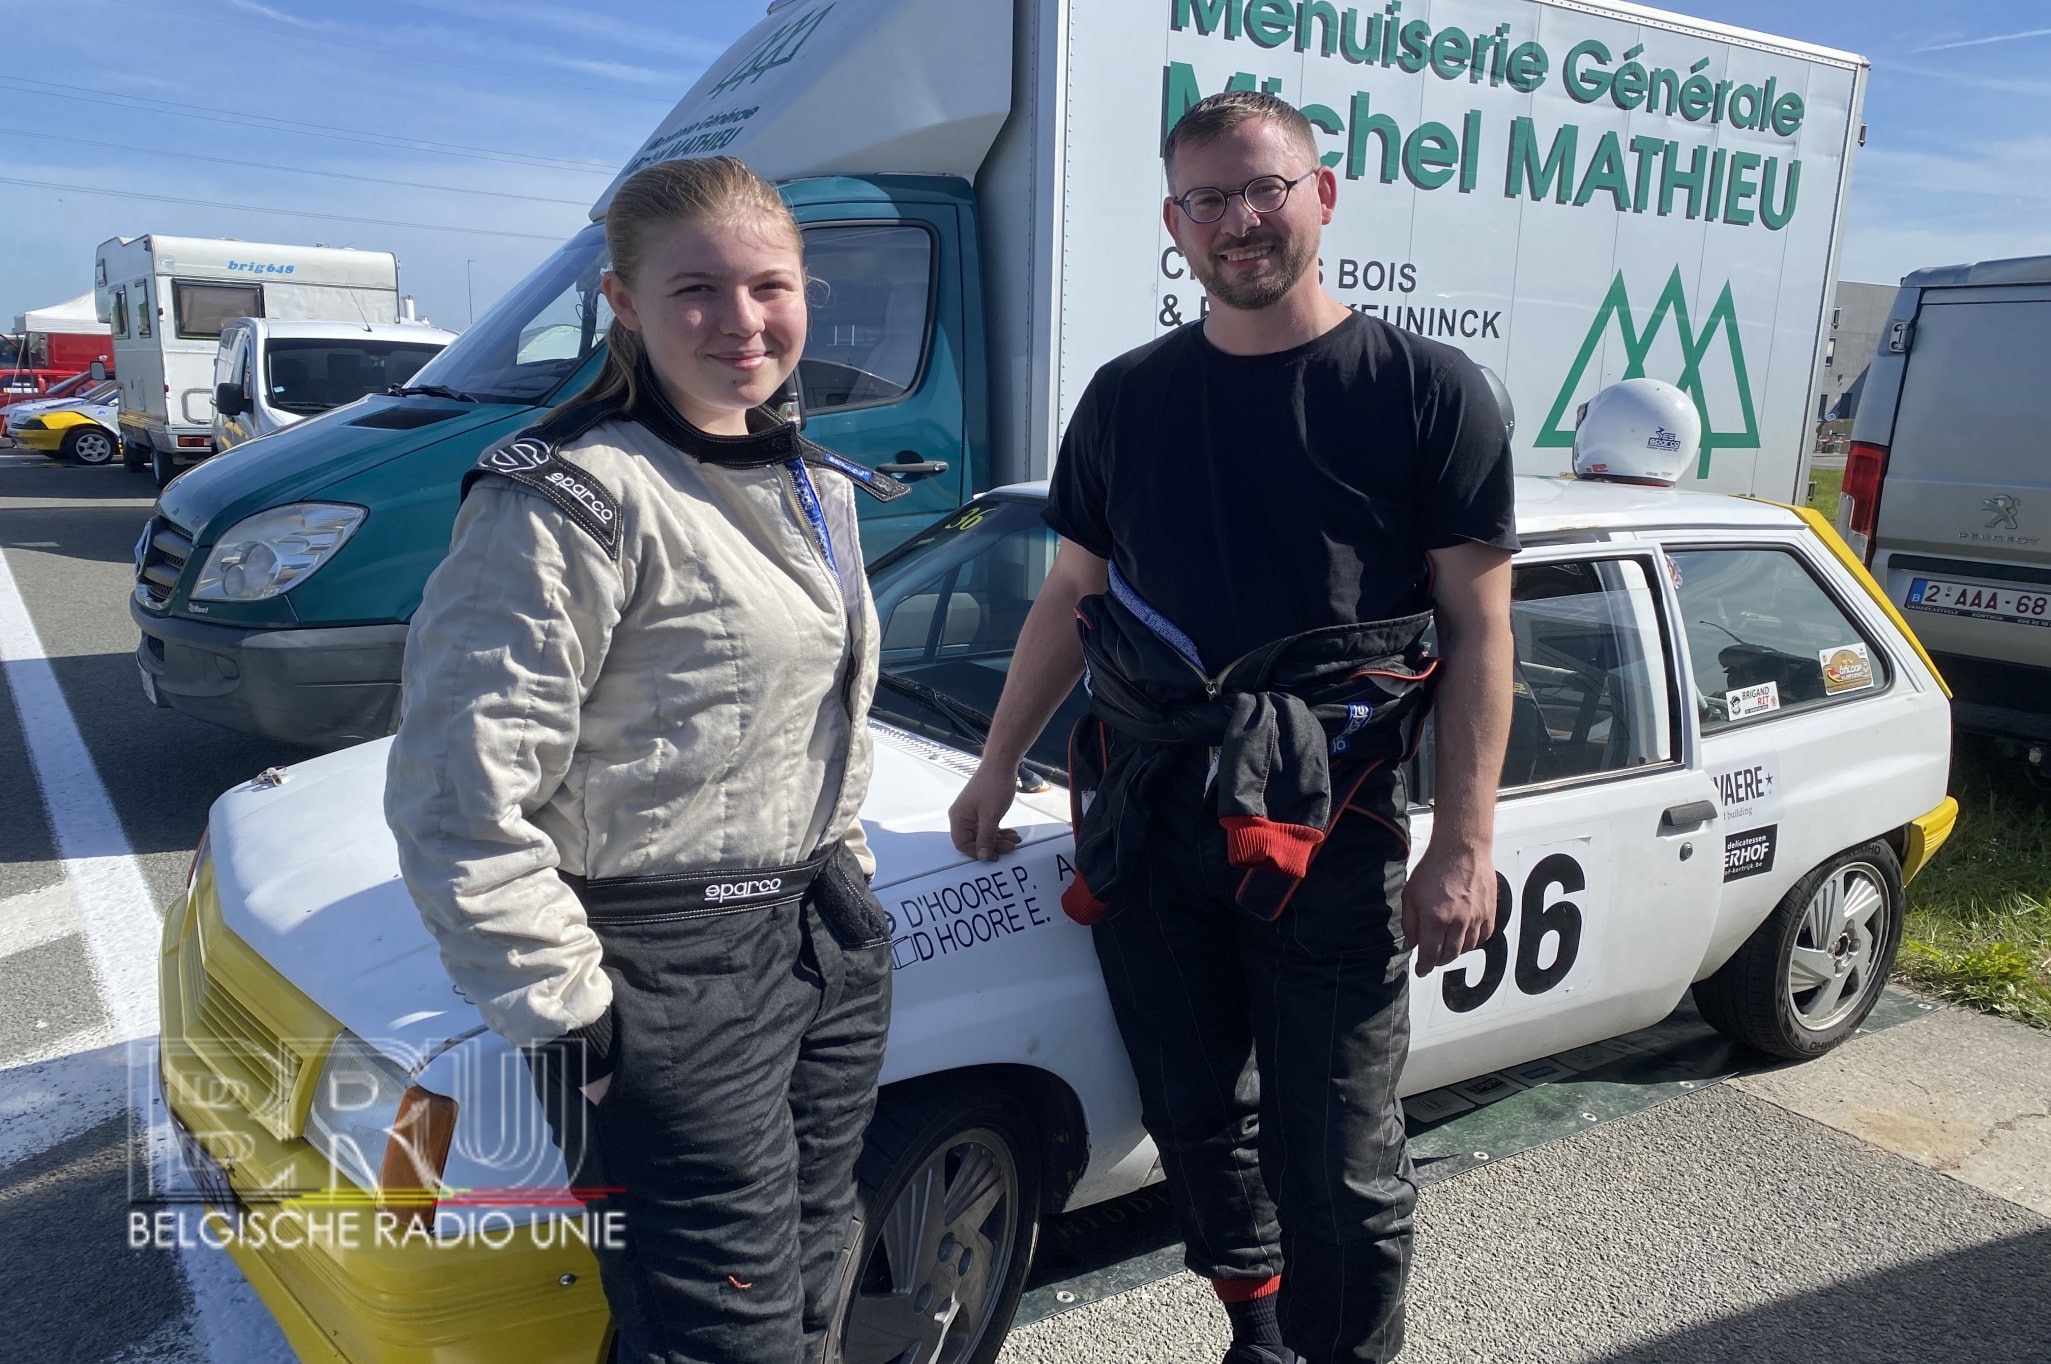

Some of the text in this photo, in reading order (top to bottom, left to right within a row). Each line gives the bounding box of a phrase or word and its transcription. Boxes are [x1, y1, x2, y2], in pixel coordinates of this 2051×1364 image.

[1563, 39, 1805, 137] Générale
[1160, 61, 1802, 231] Mchel MATHIEU
[1338, 259, 1417, 293] BOIS
[1159, 294, 1183, 327] &
[1911, 593, 1921, 602] B
[1741, 686, 1770, 701] BRIGAND
[1757, 695, 1769, 706] RIT
[1727, 807, 1753, 820] building
[1727, 835, 1767, 850] delicatessen
[704, 878, 782, 903] sparco
[900, 871, 1014, 928] D'HOORE
